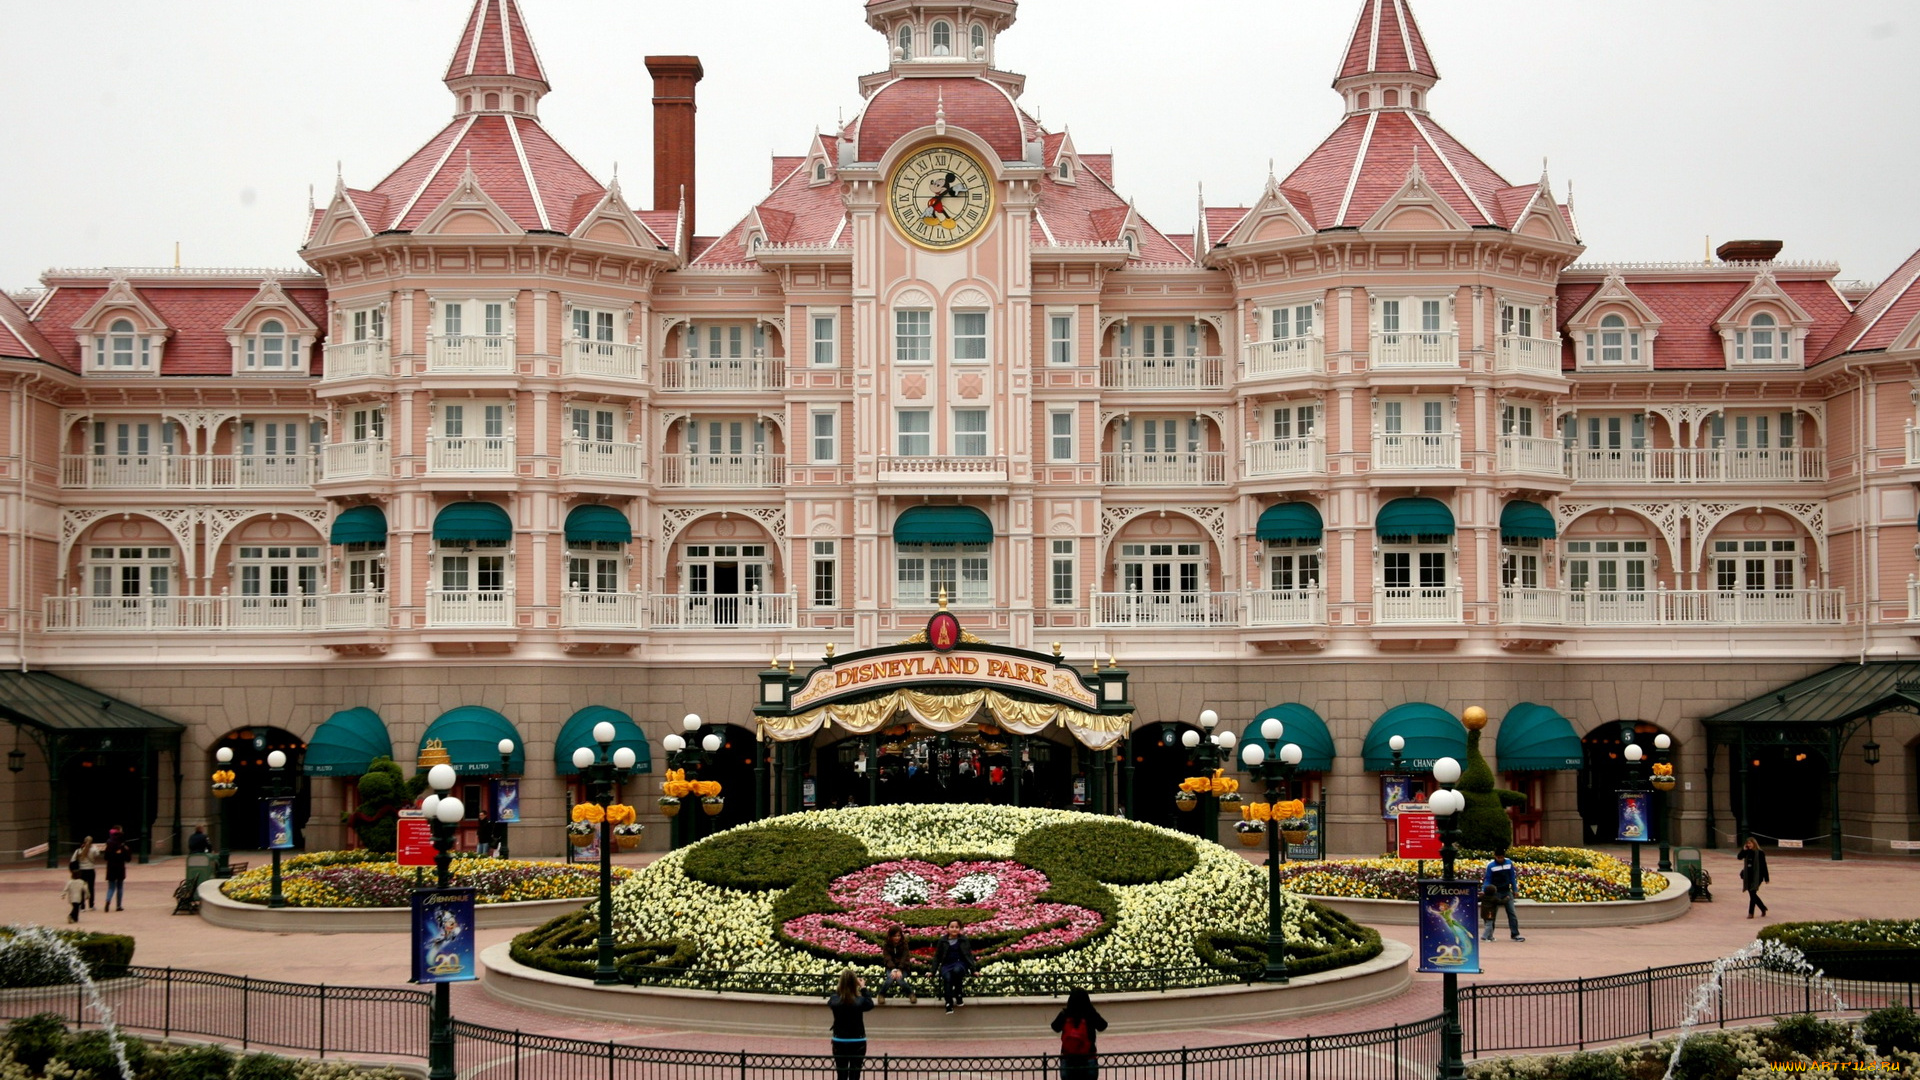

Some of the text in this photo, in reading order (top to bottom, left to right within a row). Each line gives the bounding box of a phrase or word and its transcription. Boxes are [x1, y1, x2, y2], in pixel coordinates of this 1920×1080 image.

[916, 160, 928, 172] XI
[935, 155, 946, 166] XII
[835, 656, 1048, 688] DISNEYLAND PARK
[426, 738, 442, 749] 20
[1413, 759, 1437, 767] CHANG
[1427, 884, 1470, 895] WELCOME
[423, 893, 468, 905] BIENVENUE
[1436, 944, 1463, 965] 20
[434, 953, 460, 975] 20
